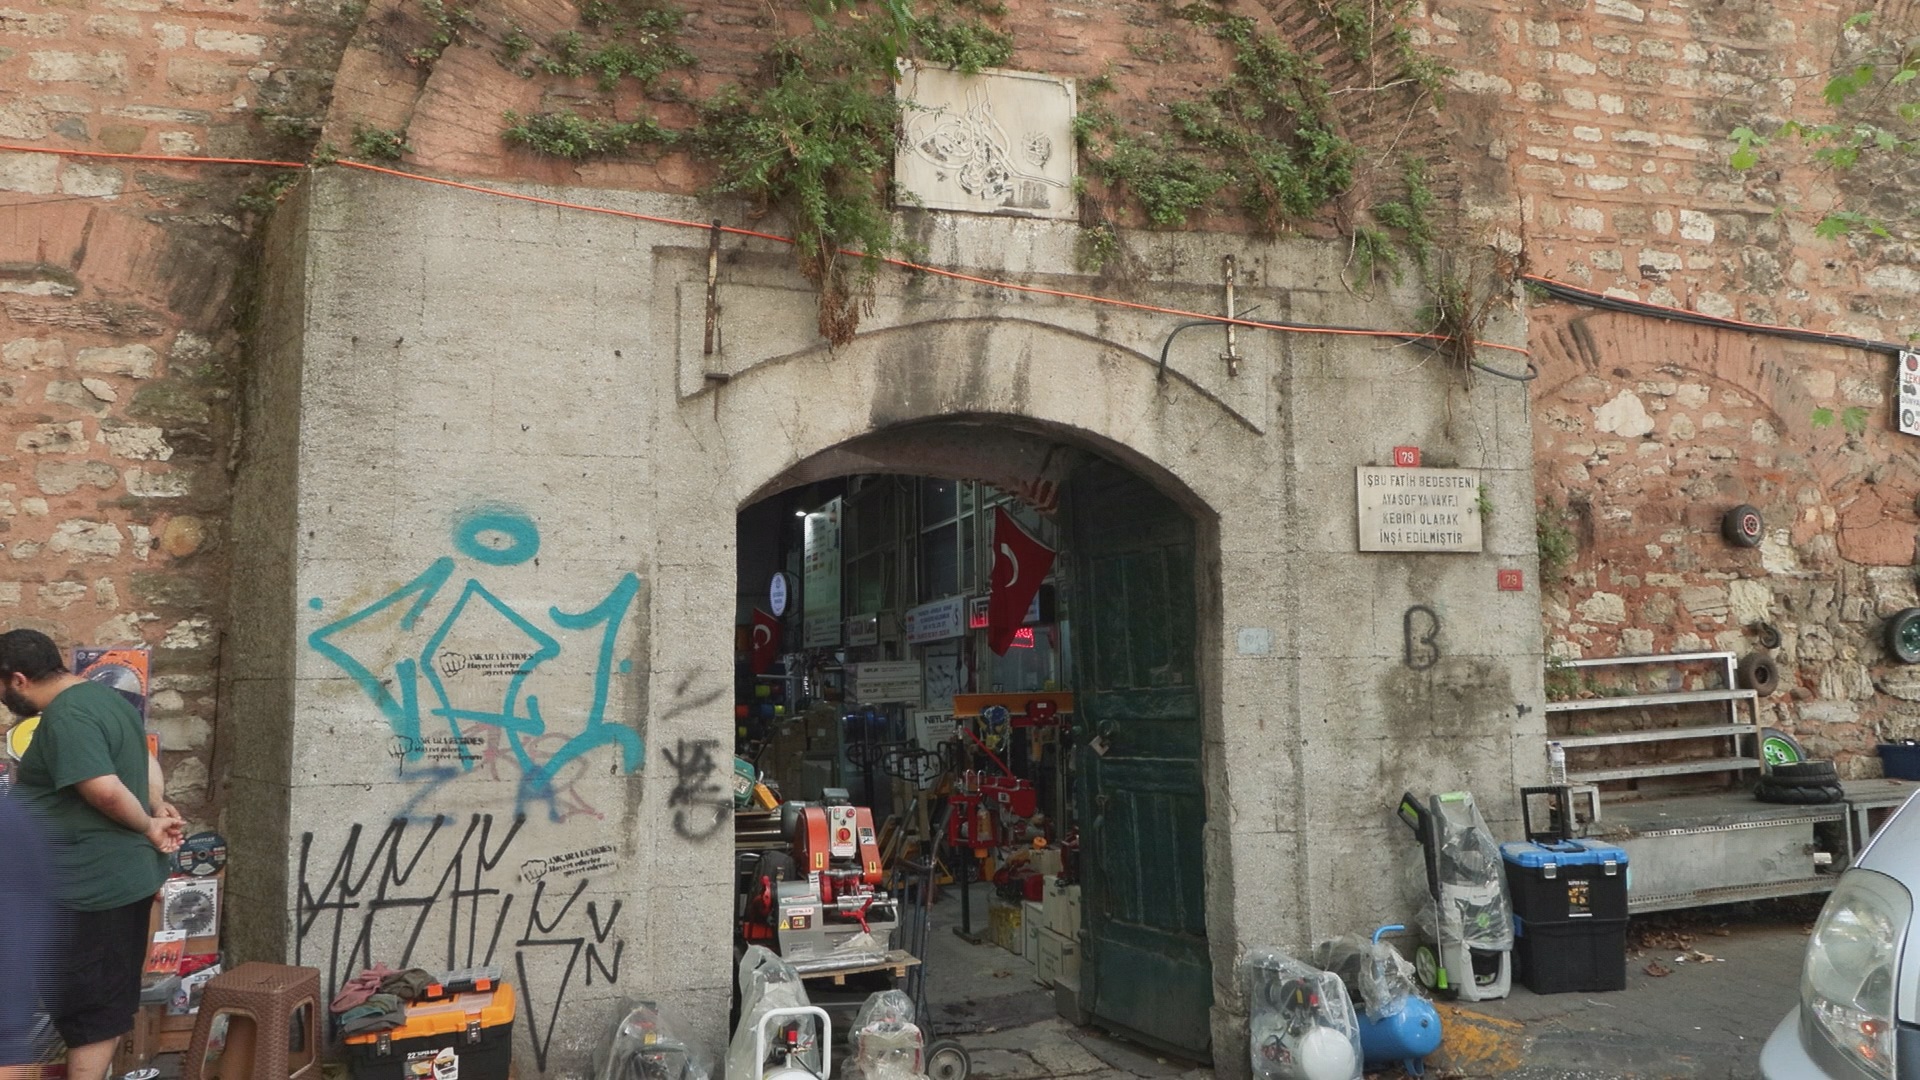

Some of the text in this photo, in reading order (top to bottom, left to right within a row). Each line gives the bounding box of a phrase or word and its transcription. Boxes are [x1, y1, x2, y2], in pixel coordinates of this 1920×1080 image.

[1402, 451, 1414, 463] 79
[1382, 494, 1428, 507] AYASOFYA
[1419, 513, 1459, 526] OLARAK
[1505, 574, 1517, 586] 79
